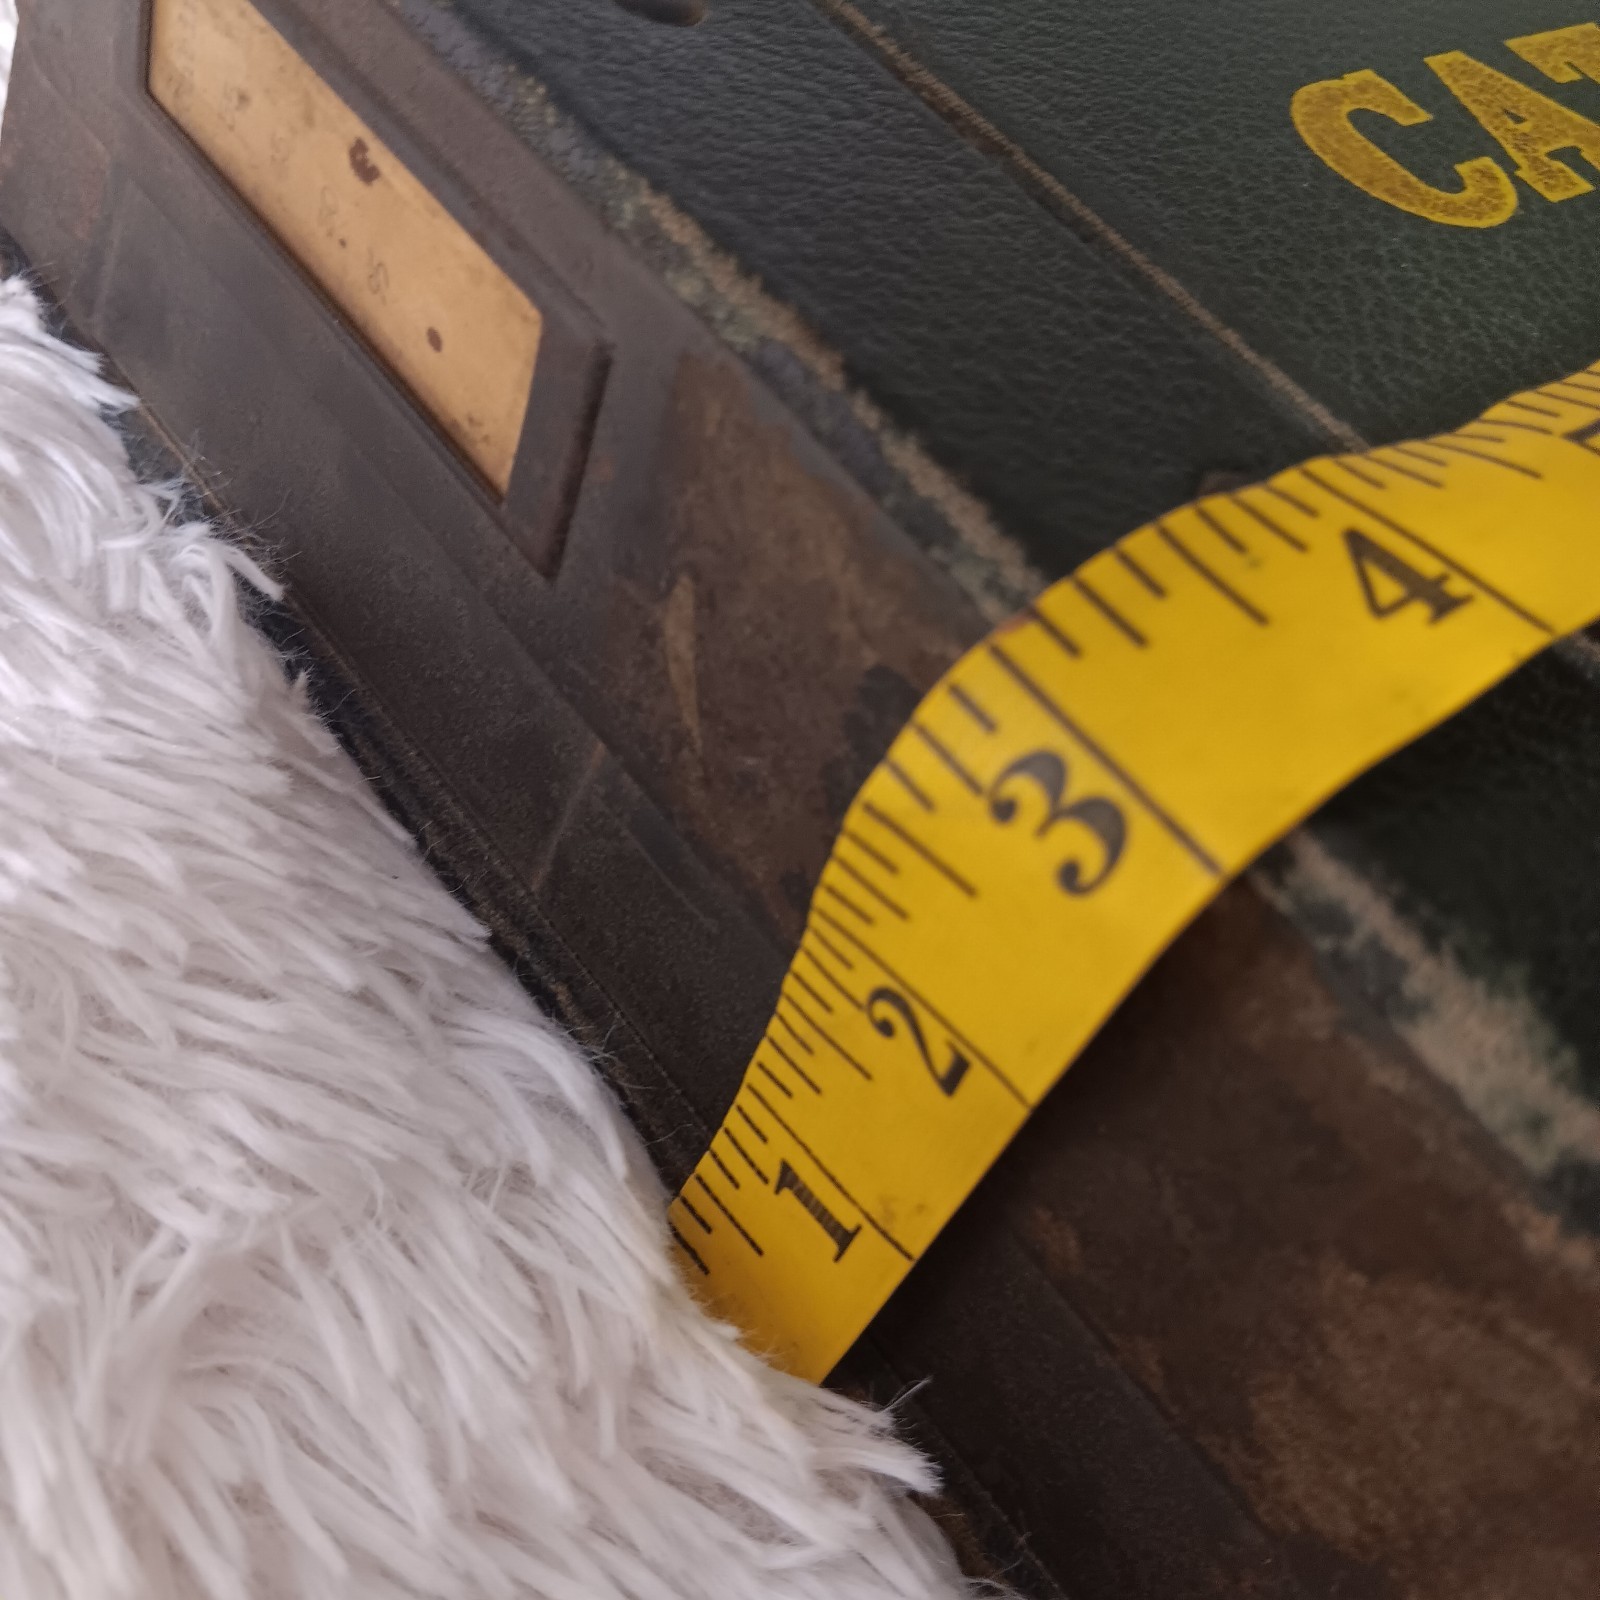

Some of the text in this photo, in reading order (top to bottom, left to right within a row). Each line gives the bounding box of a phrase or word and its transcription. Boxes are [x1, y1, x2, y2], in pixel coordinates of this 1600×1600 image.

[1343, 526, 1474, 626] 4
[987, 750, 1129, 898] 3
[864, 986, 971, 1097] 2
[774, 1159, 862, 1262] 1
